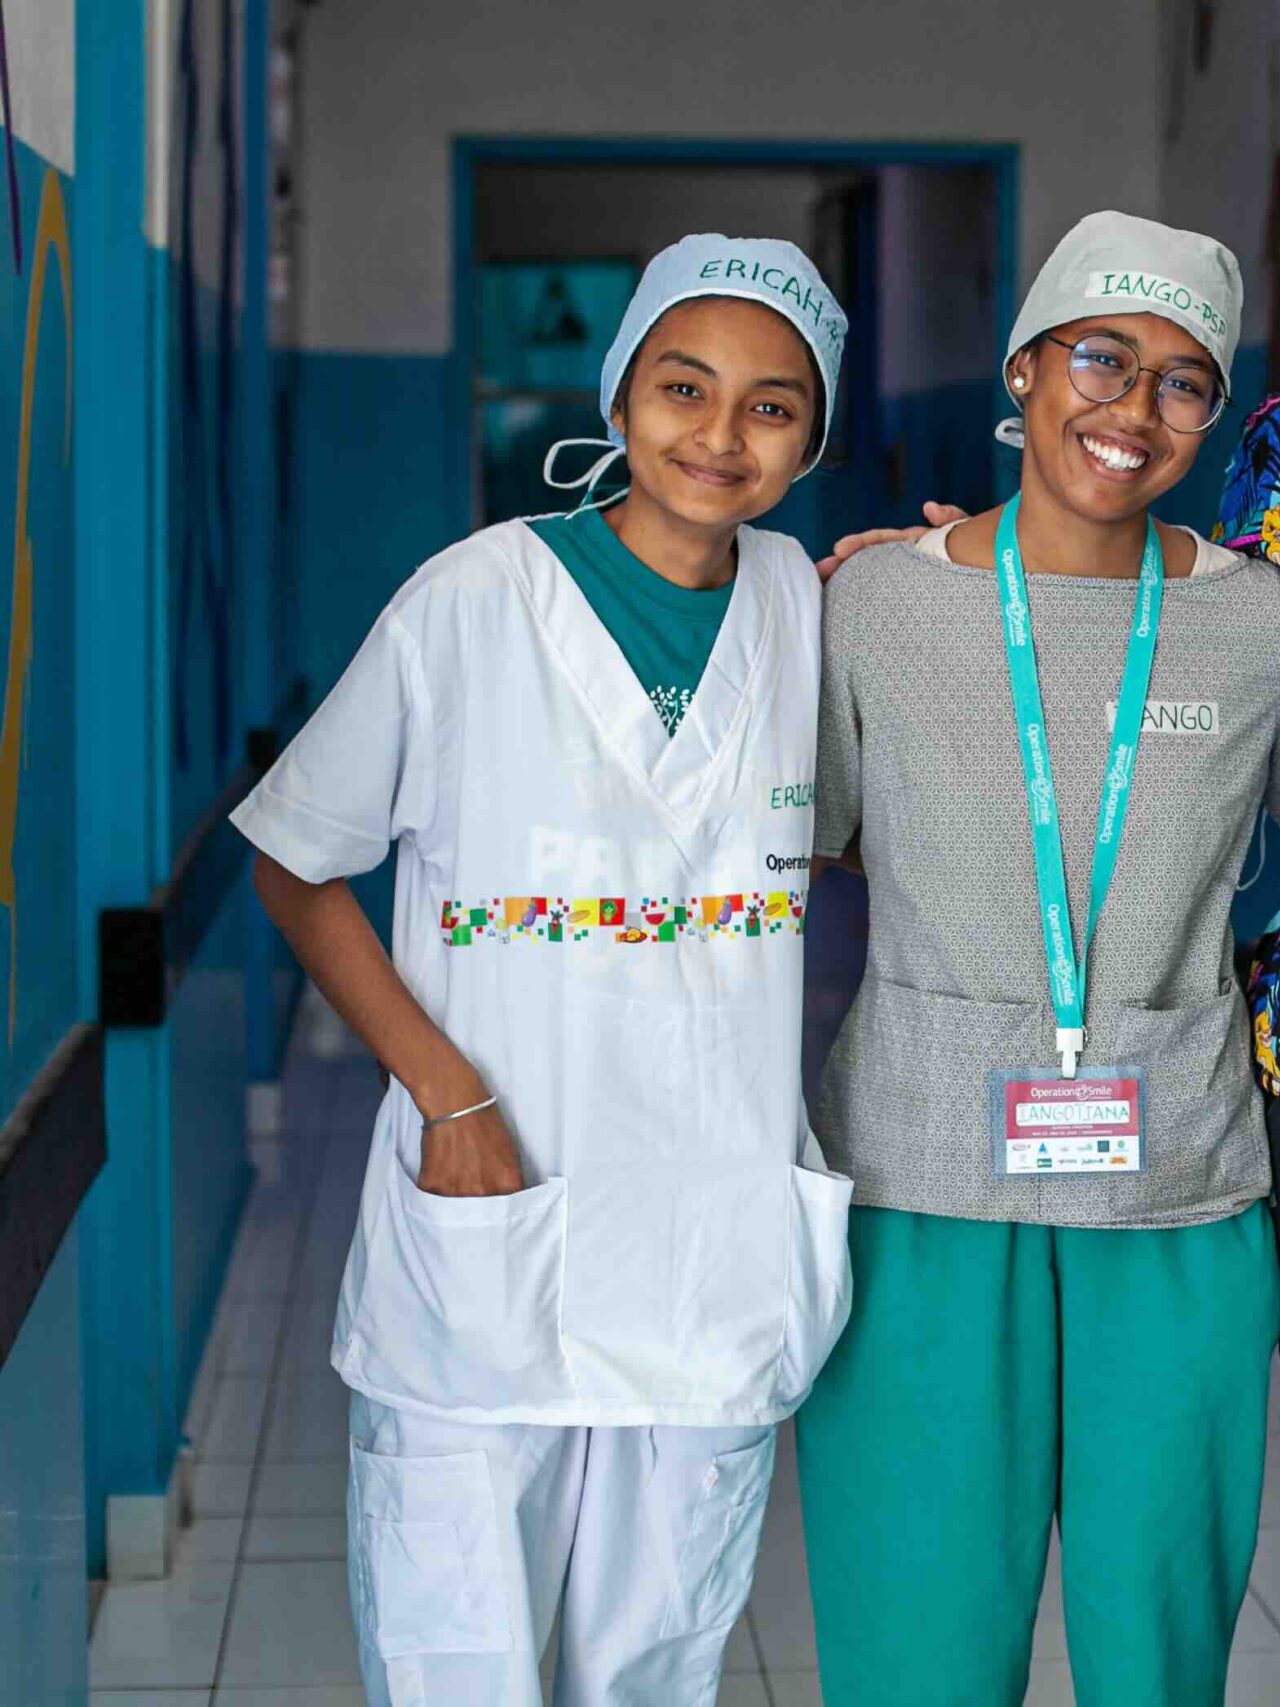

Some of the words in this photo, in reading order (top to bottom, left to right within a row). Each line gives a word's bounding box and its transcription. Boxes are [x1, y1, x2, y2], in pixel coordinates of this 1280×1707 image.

[1141, 705, 1212, 731] ANGO
[1031, 1086, 1075, 1100] Operation
[1087, 1085, 1112, 1097] Smile
